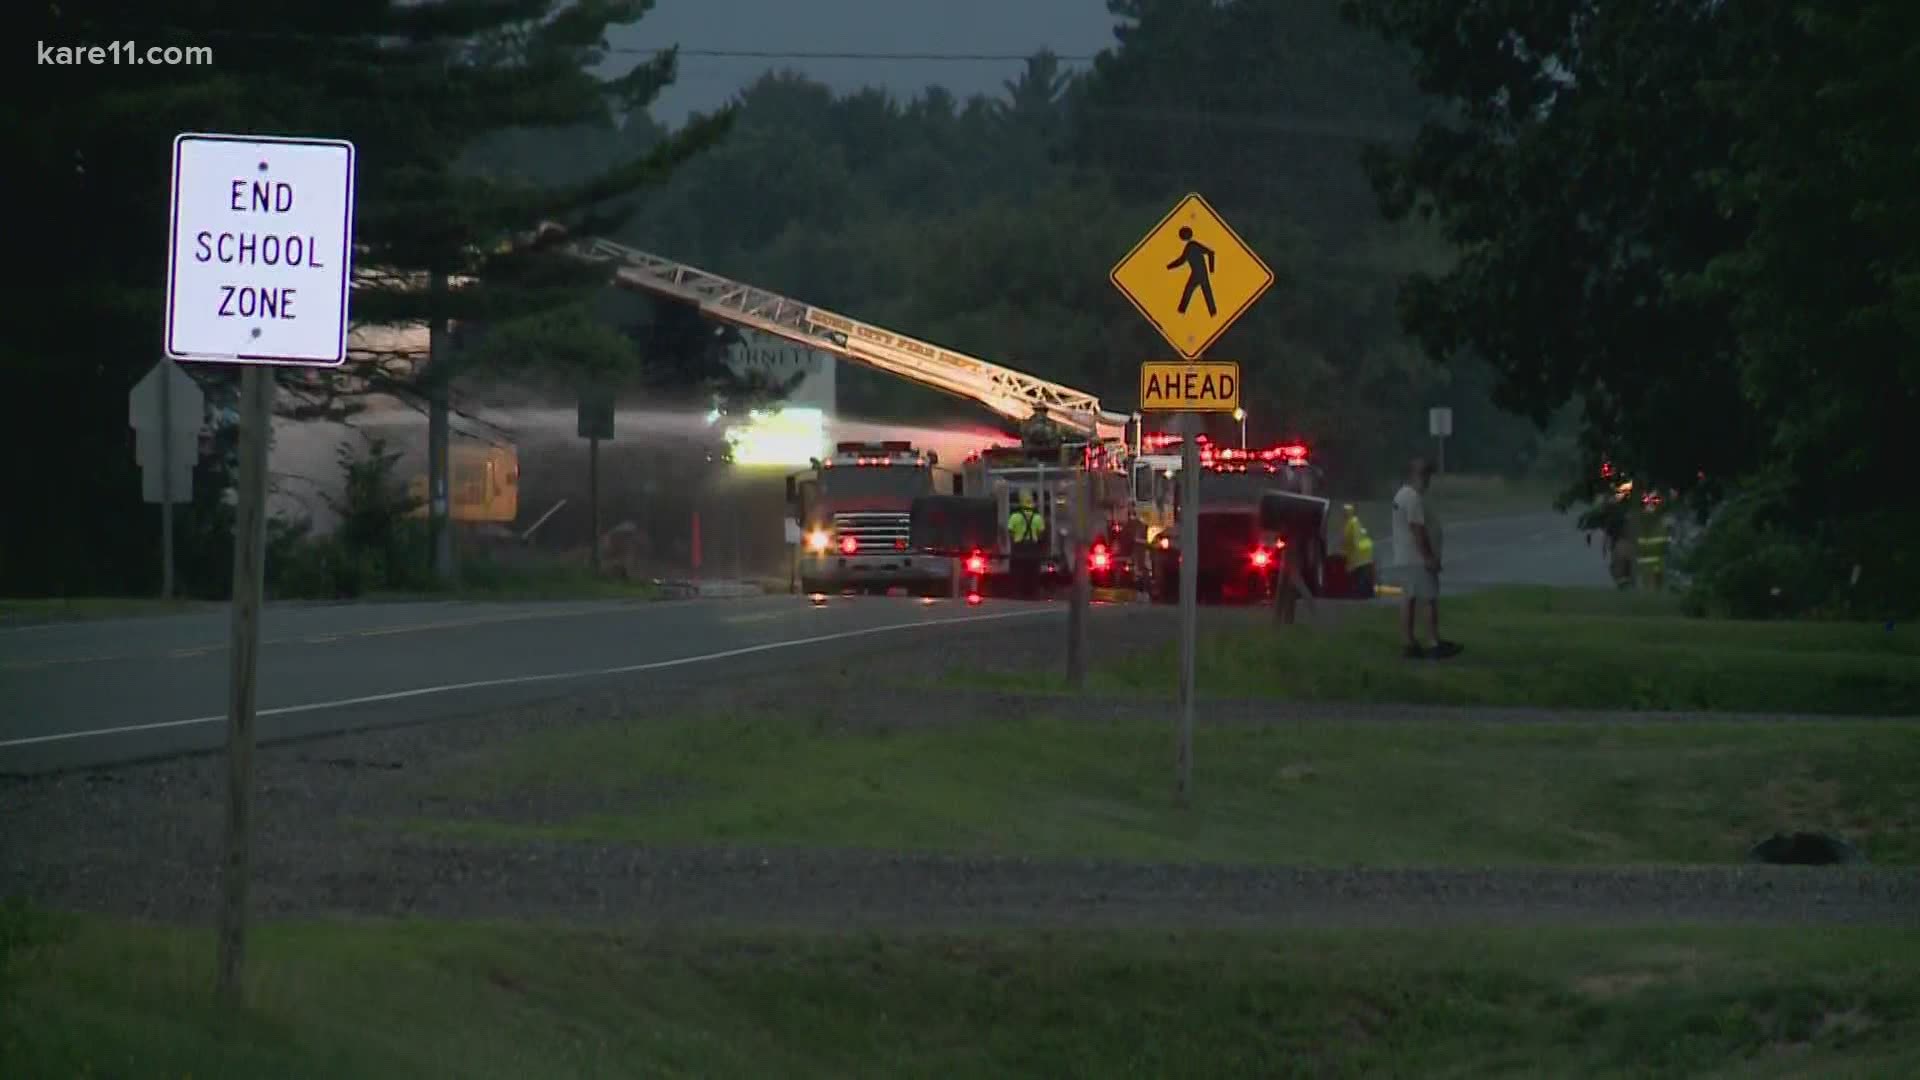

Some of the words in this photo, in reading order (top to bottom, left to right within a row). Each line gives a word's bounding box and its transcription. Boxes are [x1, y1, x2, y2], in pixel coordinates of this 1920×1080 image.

[230, 181, 293, 212] END
[195, 231, 325, 268] SCHOOL
[217, 286, 297, 320] ZONE
[1145, 373, 1235, 400] AHEAD
